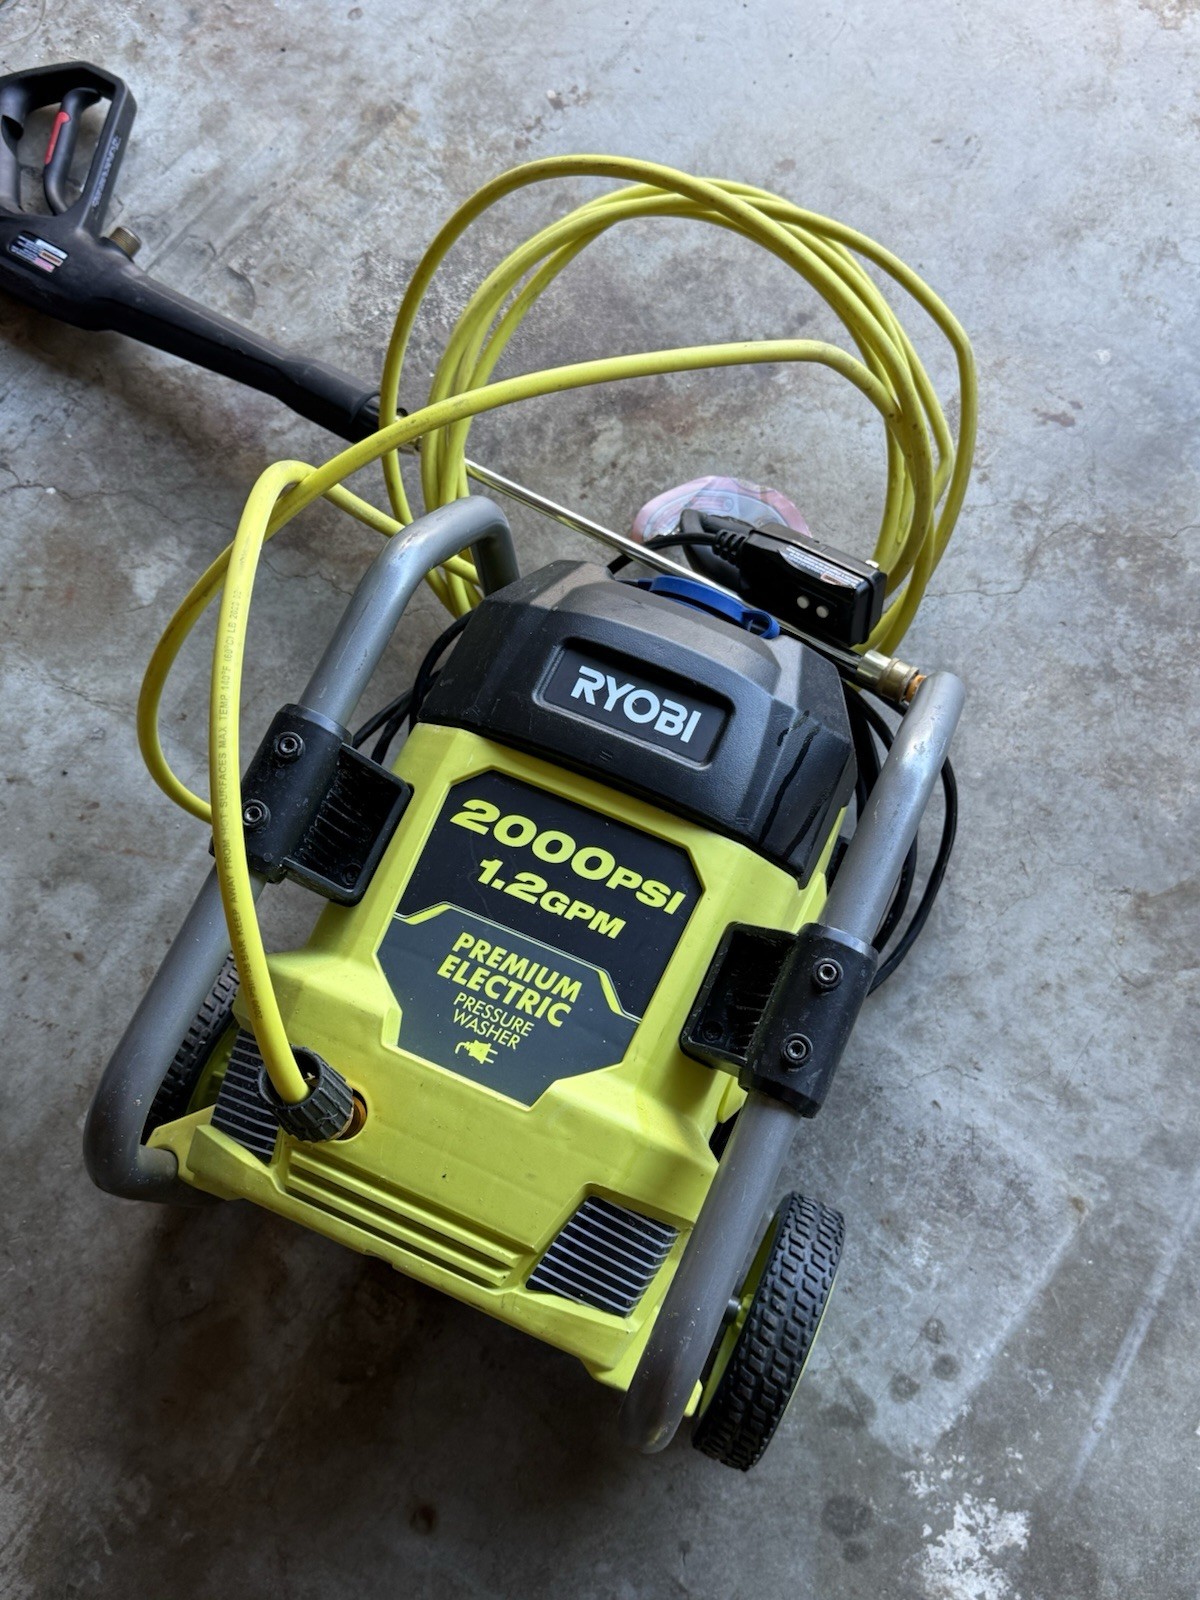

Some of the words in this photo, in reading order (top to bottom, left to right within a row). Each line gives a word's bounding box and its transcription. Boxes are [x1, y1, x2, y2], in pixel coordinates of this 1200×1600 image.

[570, 665, 702, 744] RYOBI
[218, 727, 227, 749] MAX
[218, 753, 228, 808] SURFACES
[219, 813, 230, 836] HOT
[222, 839, 233, 870] FROM
[450, 799, 686, 915] 2000PSI
[226, 875, 238, 903] AWAY
[477, 858, 627, 939] 1.2GPM
[232, 909, 244, 936] KEEP
[452, 932, 583, 1003] PREMIUM
[436, 954, 572, 1028] ELECTRIC
[453, 992, 535, 1037] PRESSURE
[453, 1008, 521, 1050] WASHER
